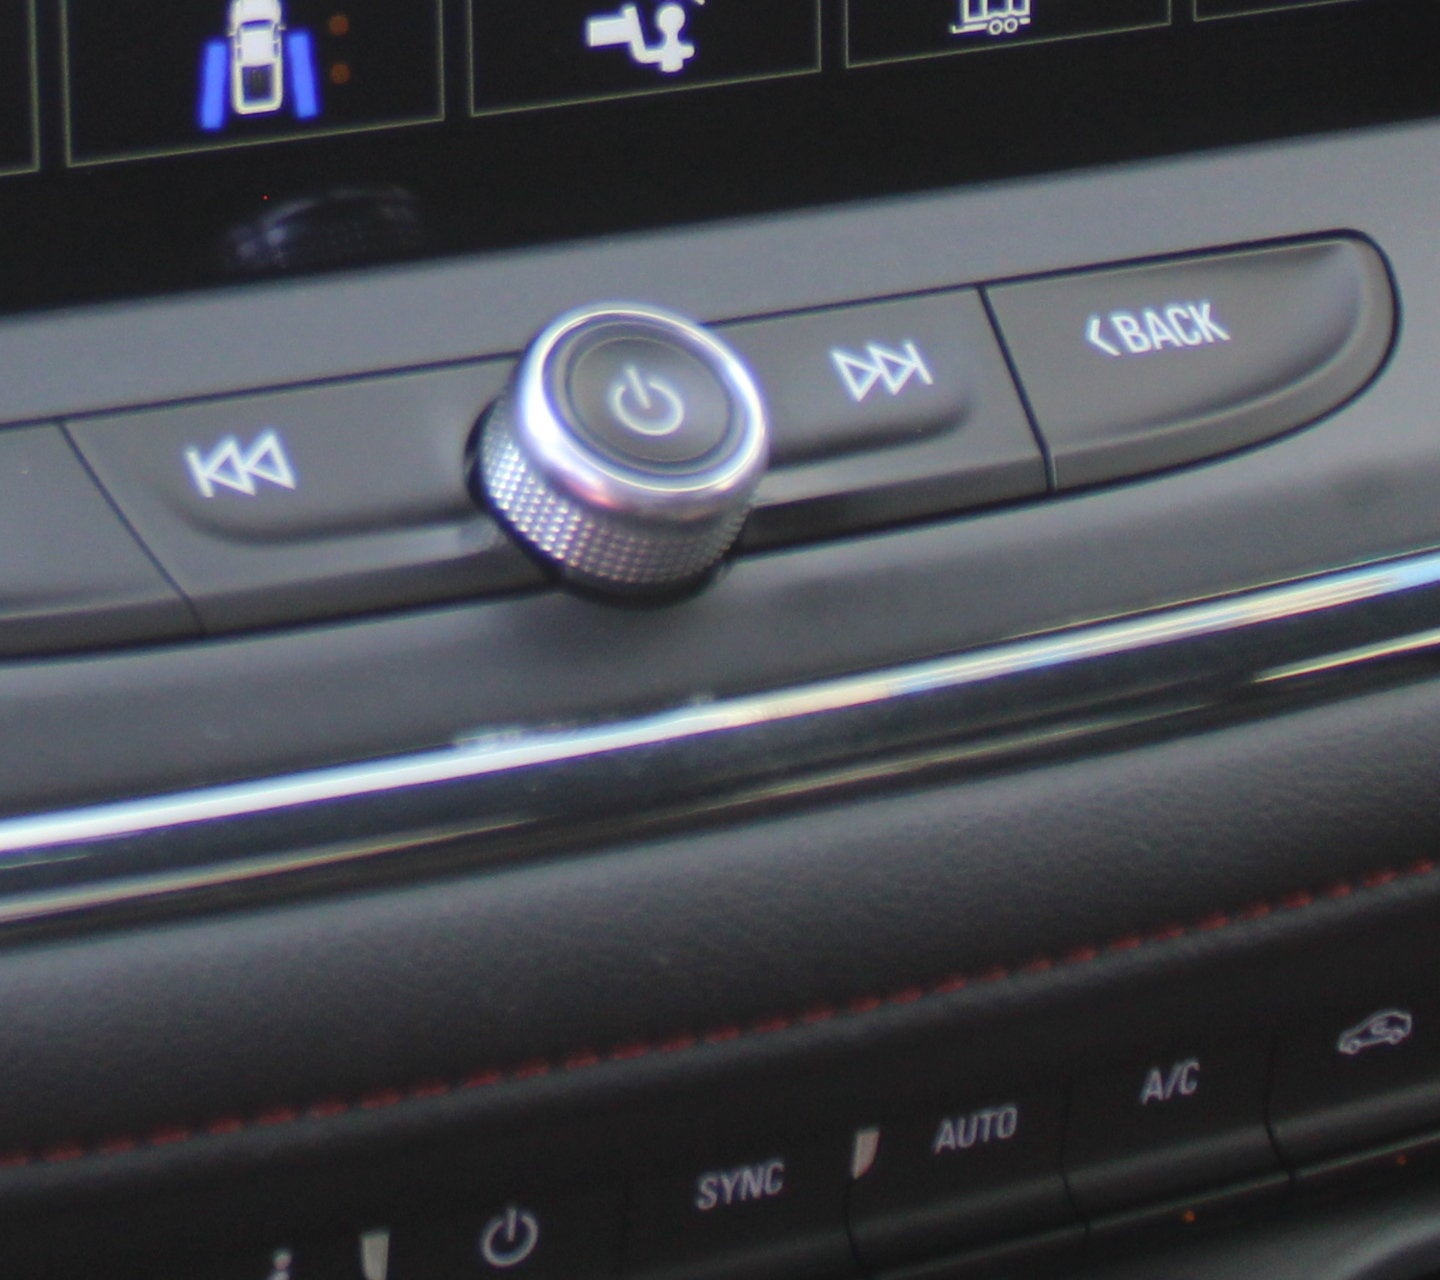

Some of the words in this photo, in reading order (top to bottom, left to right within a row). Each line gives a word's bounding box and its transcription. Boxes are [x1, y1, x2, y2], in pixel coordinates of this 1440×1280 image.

[1139, 1057, 1201, 1105] A/C
[933, 1103, 1019, 1155] AUTO
[695, 1156, 786, 1212] SYNC
